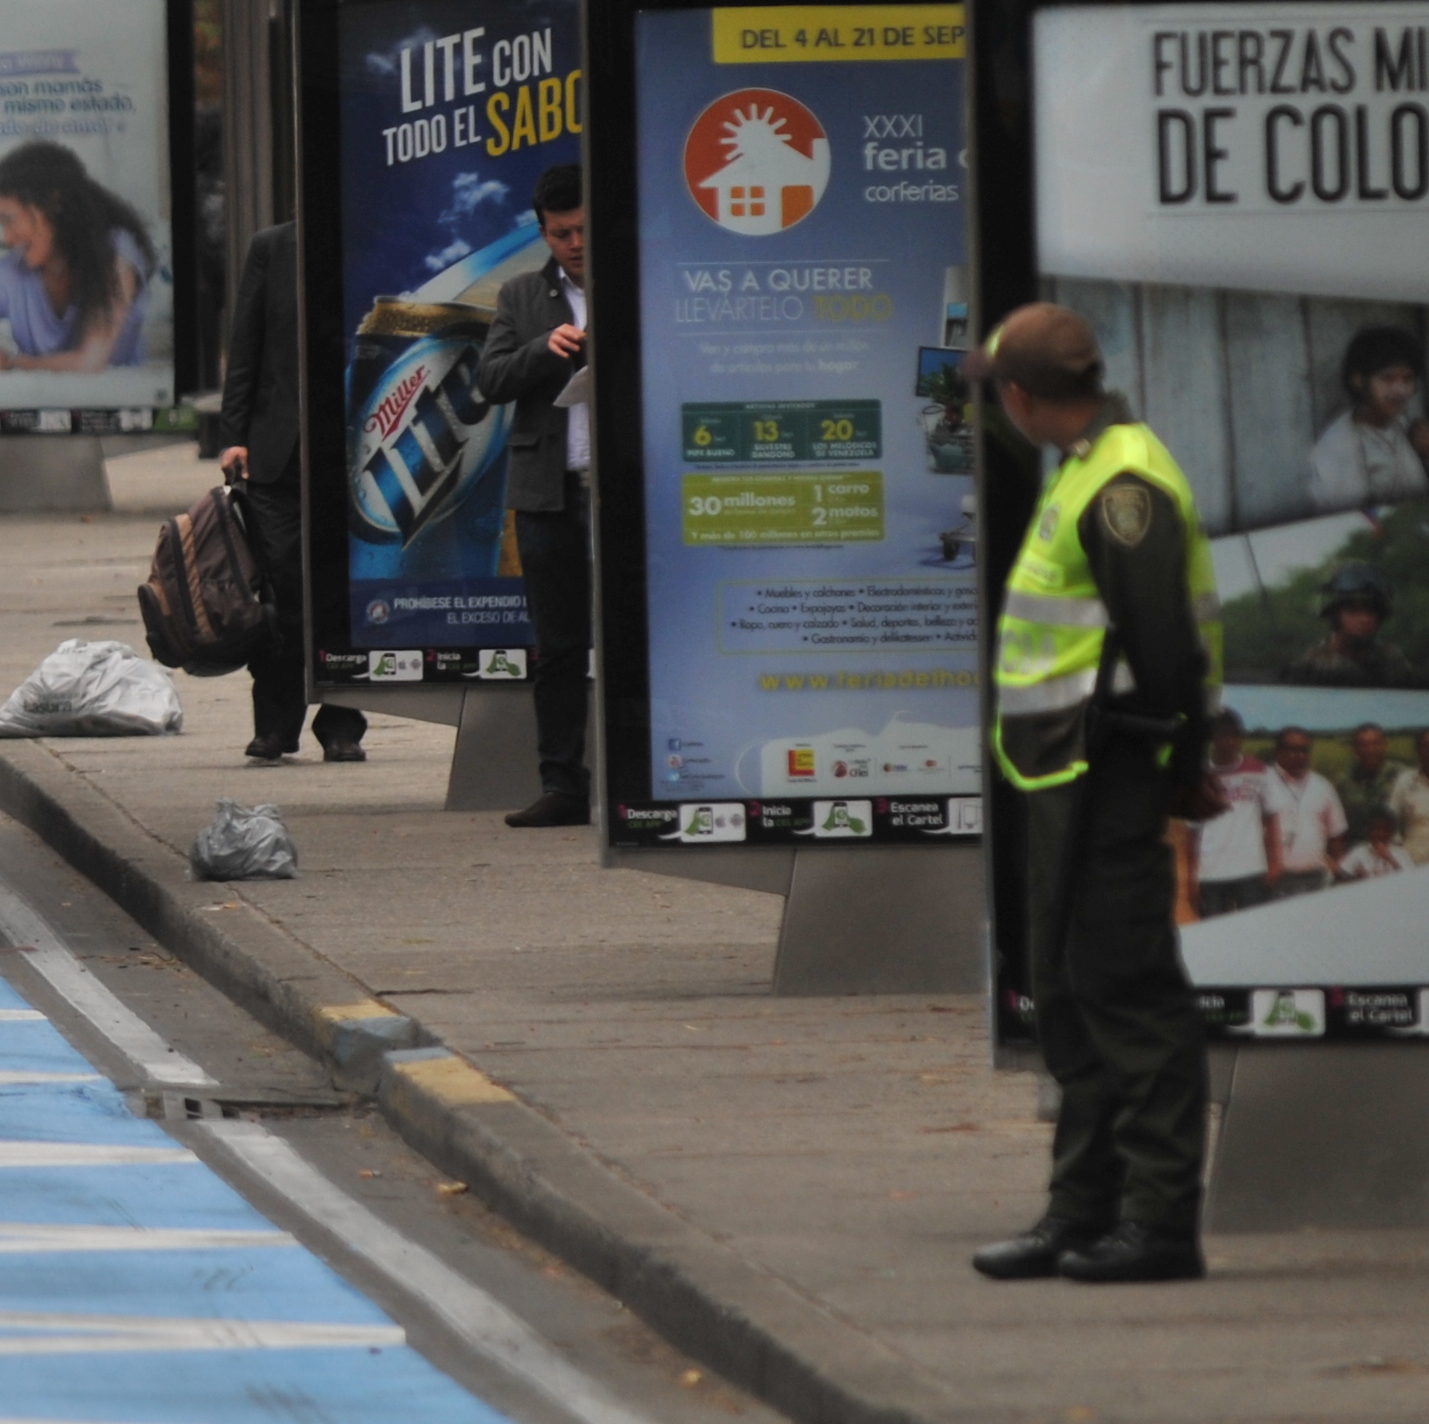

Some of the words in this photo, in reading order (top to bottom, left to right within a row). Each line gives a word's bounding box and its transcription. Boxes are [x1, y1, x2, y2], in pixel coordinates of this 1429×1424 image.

[742, 29, 785, 49] DEL
[795, 28, 807, 48] 4
[816, 27, 844, 47] AL
[854, 26, 875, 47] 21
[884, 26, 915, 46] DE
[924, 24, 964, 45] SEP
[400, 27, 486, 113] LITE
[493, 27, 553, 88] CON
[1153, 27, 1356, 97] FUERZAS
[34, 77, 102, 94] mamás
[5, 96, 66, 113] mismo
[864, 115, 923, 138] XXXI
[383, 114, 447, 166] TODO
[454, 105, 481, 148] EL
[864, 142, 946, 171] feria
[1158, 107, 1238, 204] DE
[1265, 102, 1429, 204] COLO
[865, 179, 959, 202] corferias
[685, 270, 732, 292] VAS
[742, 270, 761, 291] A
[769, 268, 873, 291] QUERER
[676, 292, 804, 322] LLEVÁRTELO
[814, 294, 893, 322] TODO
[819, 359, 859, 374] hogar
[362, 365, 427, 443] Miller
[694, 425, 712, 446] 6
[752, 420, 779, 442] 13
[821, 419, 853, 441] 20
[813, 485, 823, 502] 1
[828, 484, 870, 495] carro
[689, 496, 721, 516] 30
[724, 492, 796, 507] millones
[812, 508, 828, 526] 2
[828, 506, 879, 517] motos
[765, 588, 802, 598] Muebles
[454, 596, 465, 609] EL
[468, 595, 522, 608] EXPENDIO
[757, 603, 790, 613] Cocina
[447, 612, 459, 624] EL
[462, 611, 500, 624] EXCESO
[802, 618, 840, 628] calzado
[627, 807, 678, 823] Descarga
[762, 804, 791, 816] Inicia
[891, 801, 939, 814] Escanea
[763, 817, 774, 828] la
[892, 814, 905, 826] el
[907, 813, 944, 826] Cartel
